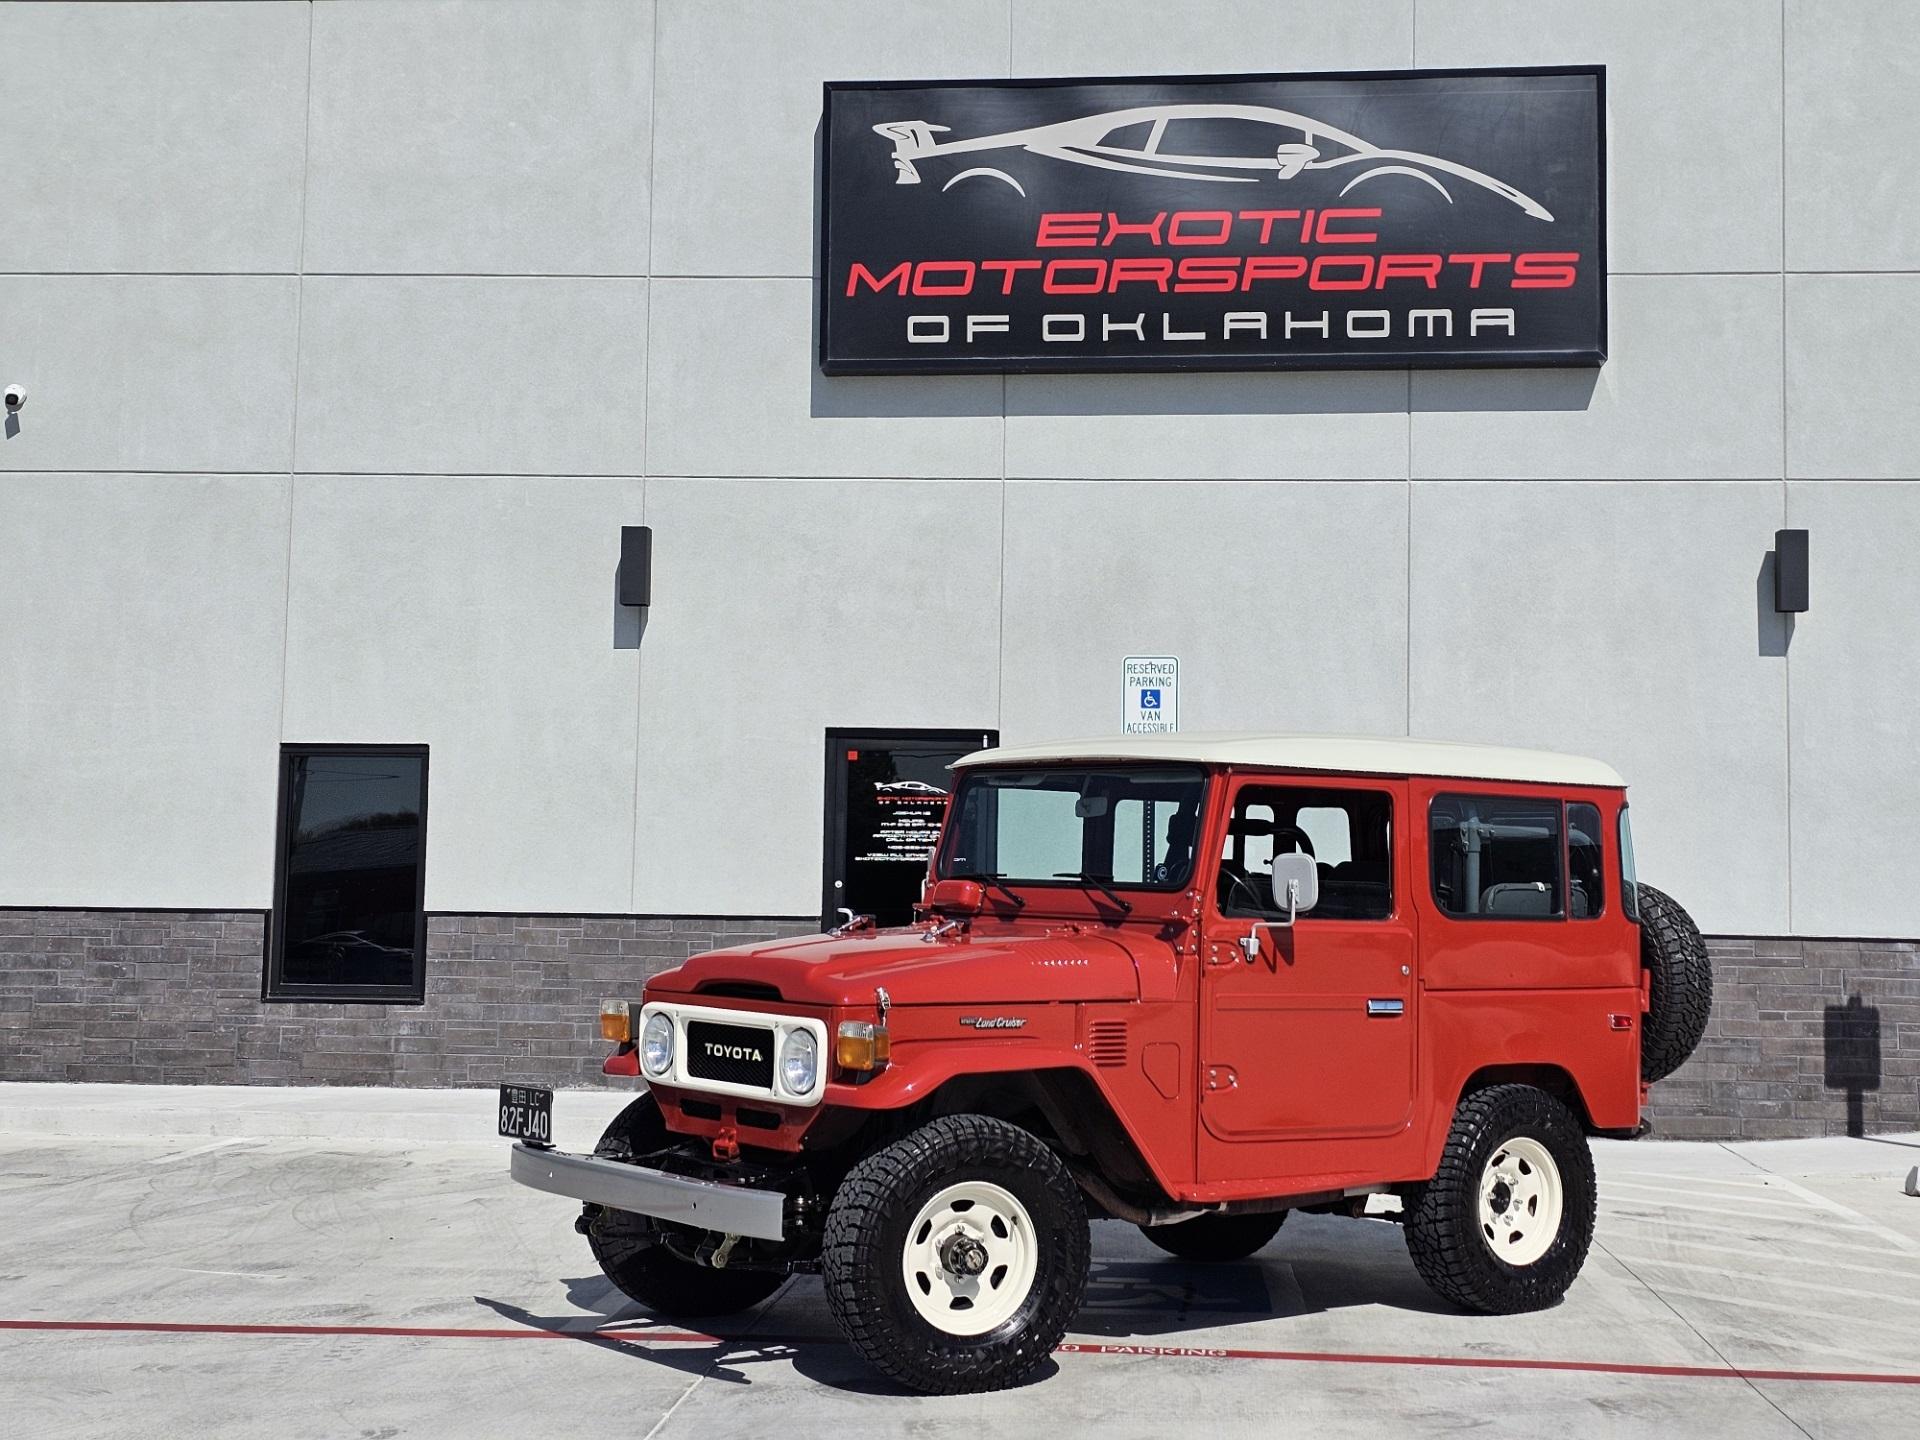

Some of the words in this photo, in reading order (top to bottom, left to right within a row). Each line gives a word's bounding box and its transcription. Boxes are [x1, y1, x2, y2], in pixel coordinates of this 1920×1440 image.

[1036, 208, 1382, 248] EXOTIC
[846, 252, 1580, 297] MOTORSPORTS
[907, 315, 1010, 343] OF
[1042, 307, 1516, 342] OKLAHOMA
[1126, 663, 1175, 675] RESERVED
[1129, 676, 1172, 687] PARKING
[1140, 710, 1161, 721] VAN
[704, 1042, 762, 1062] TOYOTA
[529, 1091, 540, 1106] LC
[500, 1105, 548, 1139] 82FJ40
[1100, 1345, 1227, 1356] PARKING
